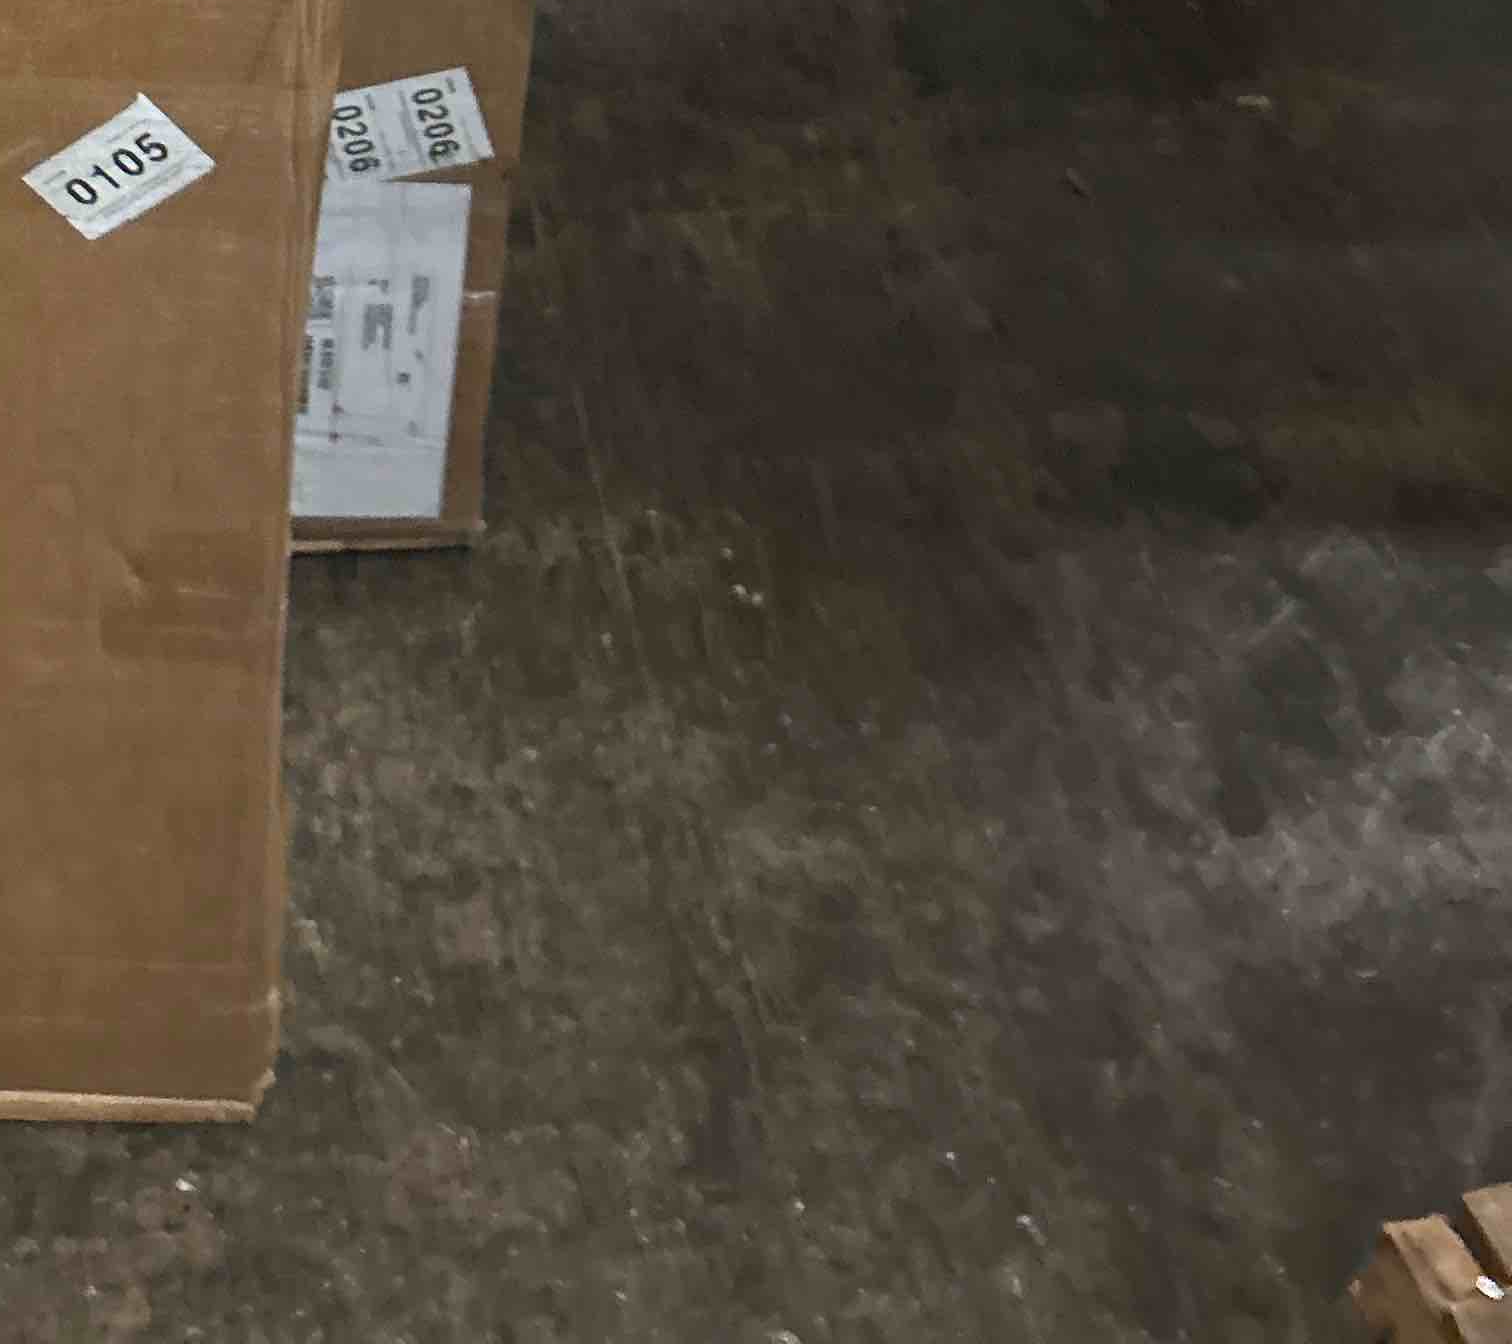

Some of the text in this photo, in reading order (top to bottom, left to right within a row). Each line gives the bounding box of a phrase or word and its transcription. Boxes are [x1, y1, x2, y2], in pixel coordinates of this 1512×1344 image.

[332, 105, 381, 173] 0206
[412, 88, 460, 162] 0206
[65, 132, 169, 205] 0105
